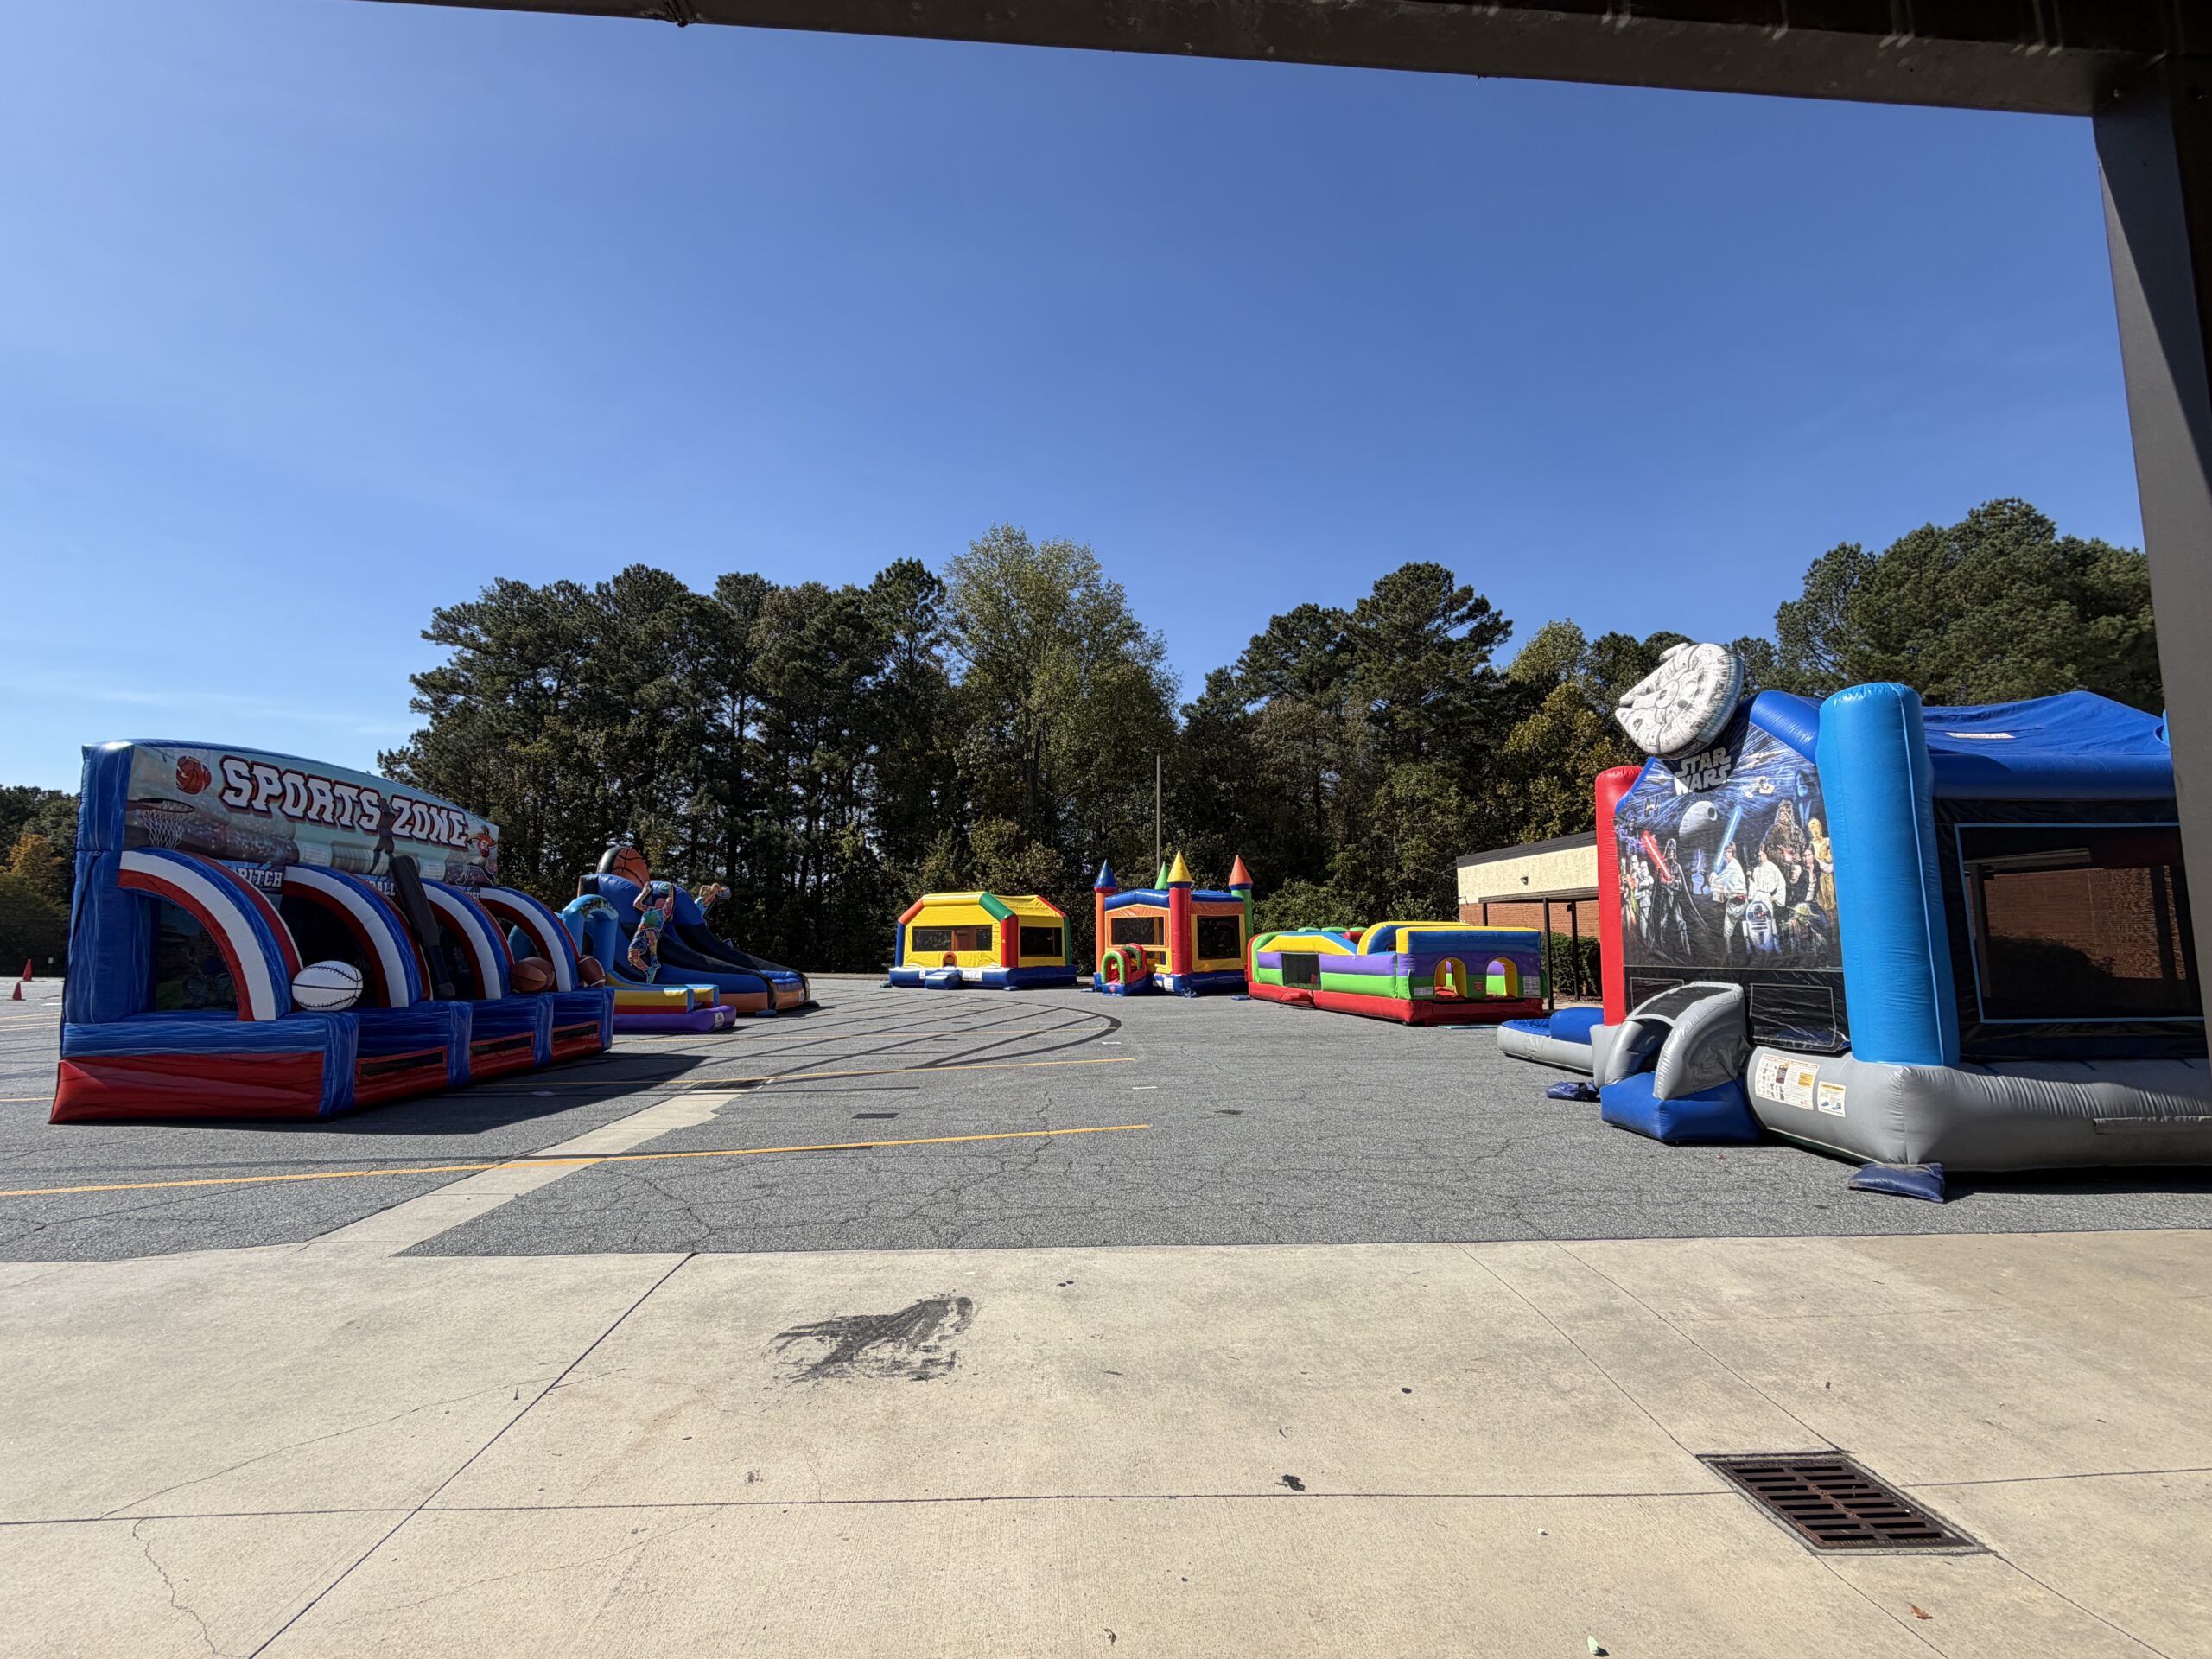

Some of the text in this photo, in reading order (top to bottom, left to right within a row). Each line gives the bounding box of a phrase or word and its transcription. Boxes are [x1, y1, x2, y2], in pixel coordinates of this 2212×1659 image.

[1675, 747, 1732, 778] STAR
[1674, 763, 1732, 796] WARS
[221, 757, 468, 849] SPORTS ZONE
